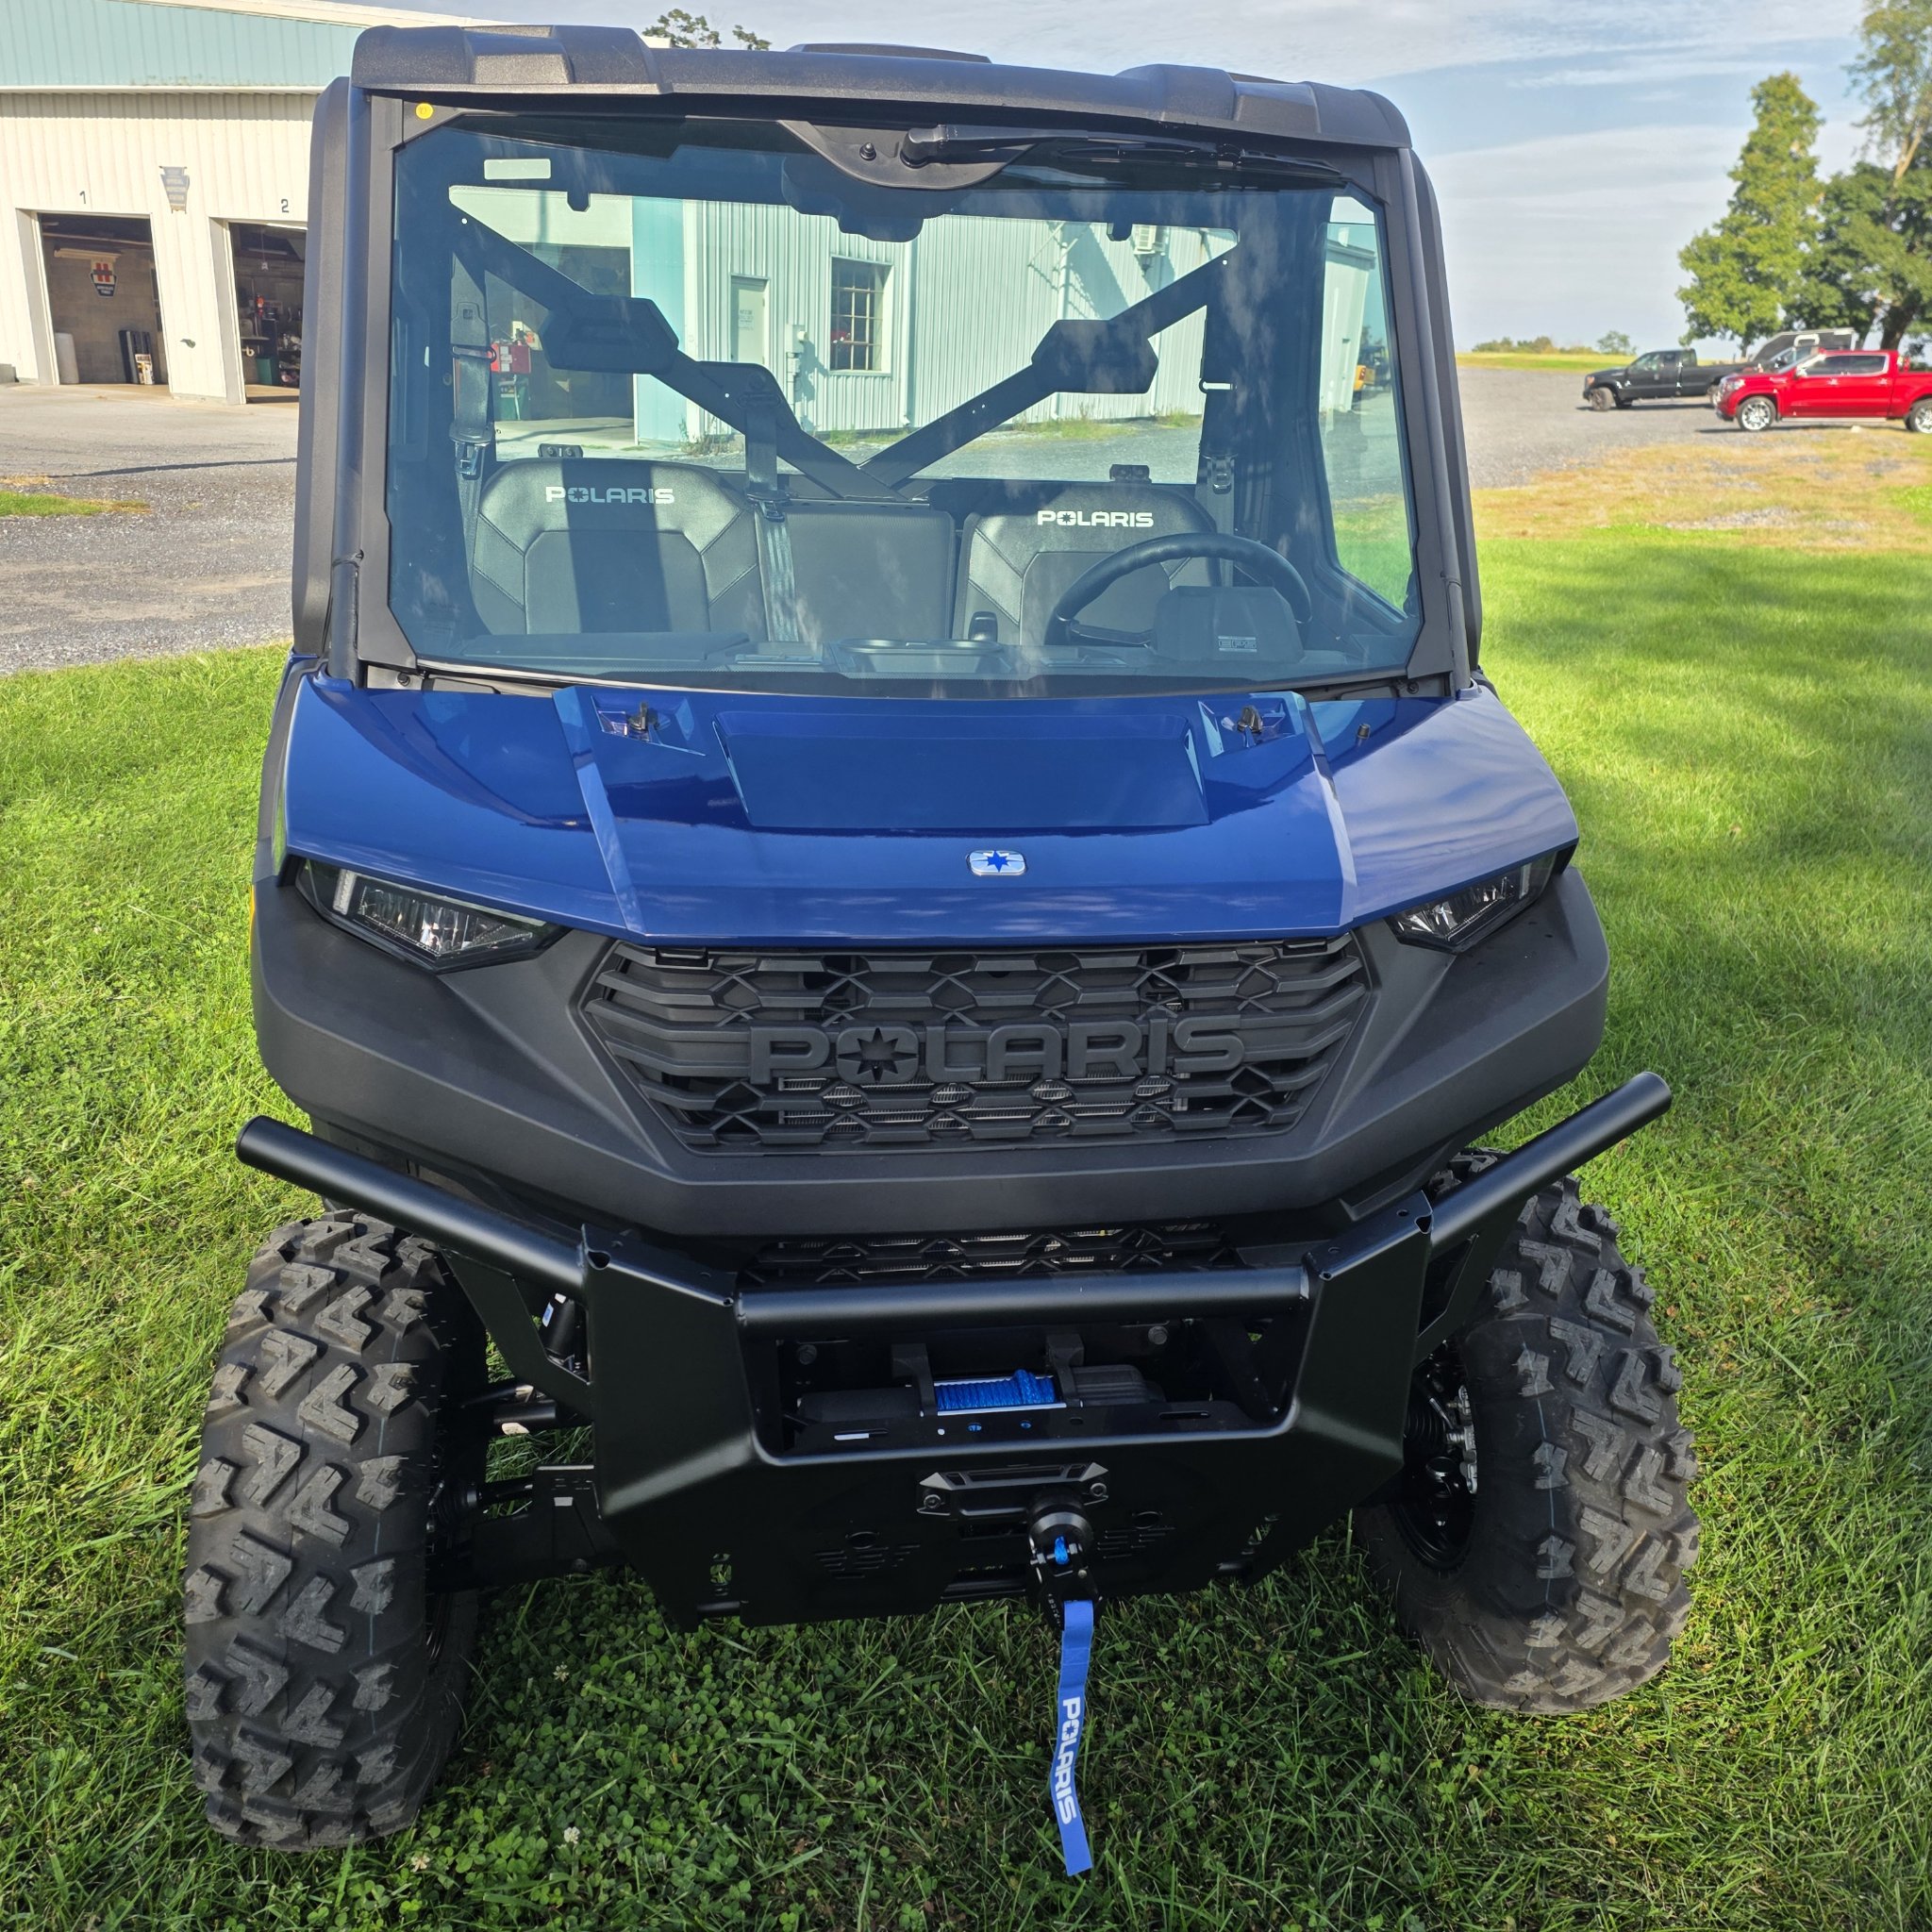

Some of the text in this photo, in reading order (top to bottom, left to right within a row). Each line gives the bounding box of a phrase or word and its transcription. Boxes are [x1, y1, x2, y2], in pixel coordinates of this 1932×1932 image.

[280, 198, 290, 213] 2
[545, 486, 675, 505] POLARIS
[1037, 510, 1155, 527] POLARIS
[751, 1014, 1244, 1084] POLARIS
[1055, 1696, 1081, 1825] POLARIS
